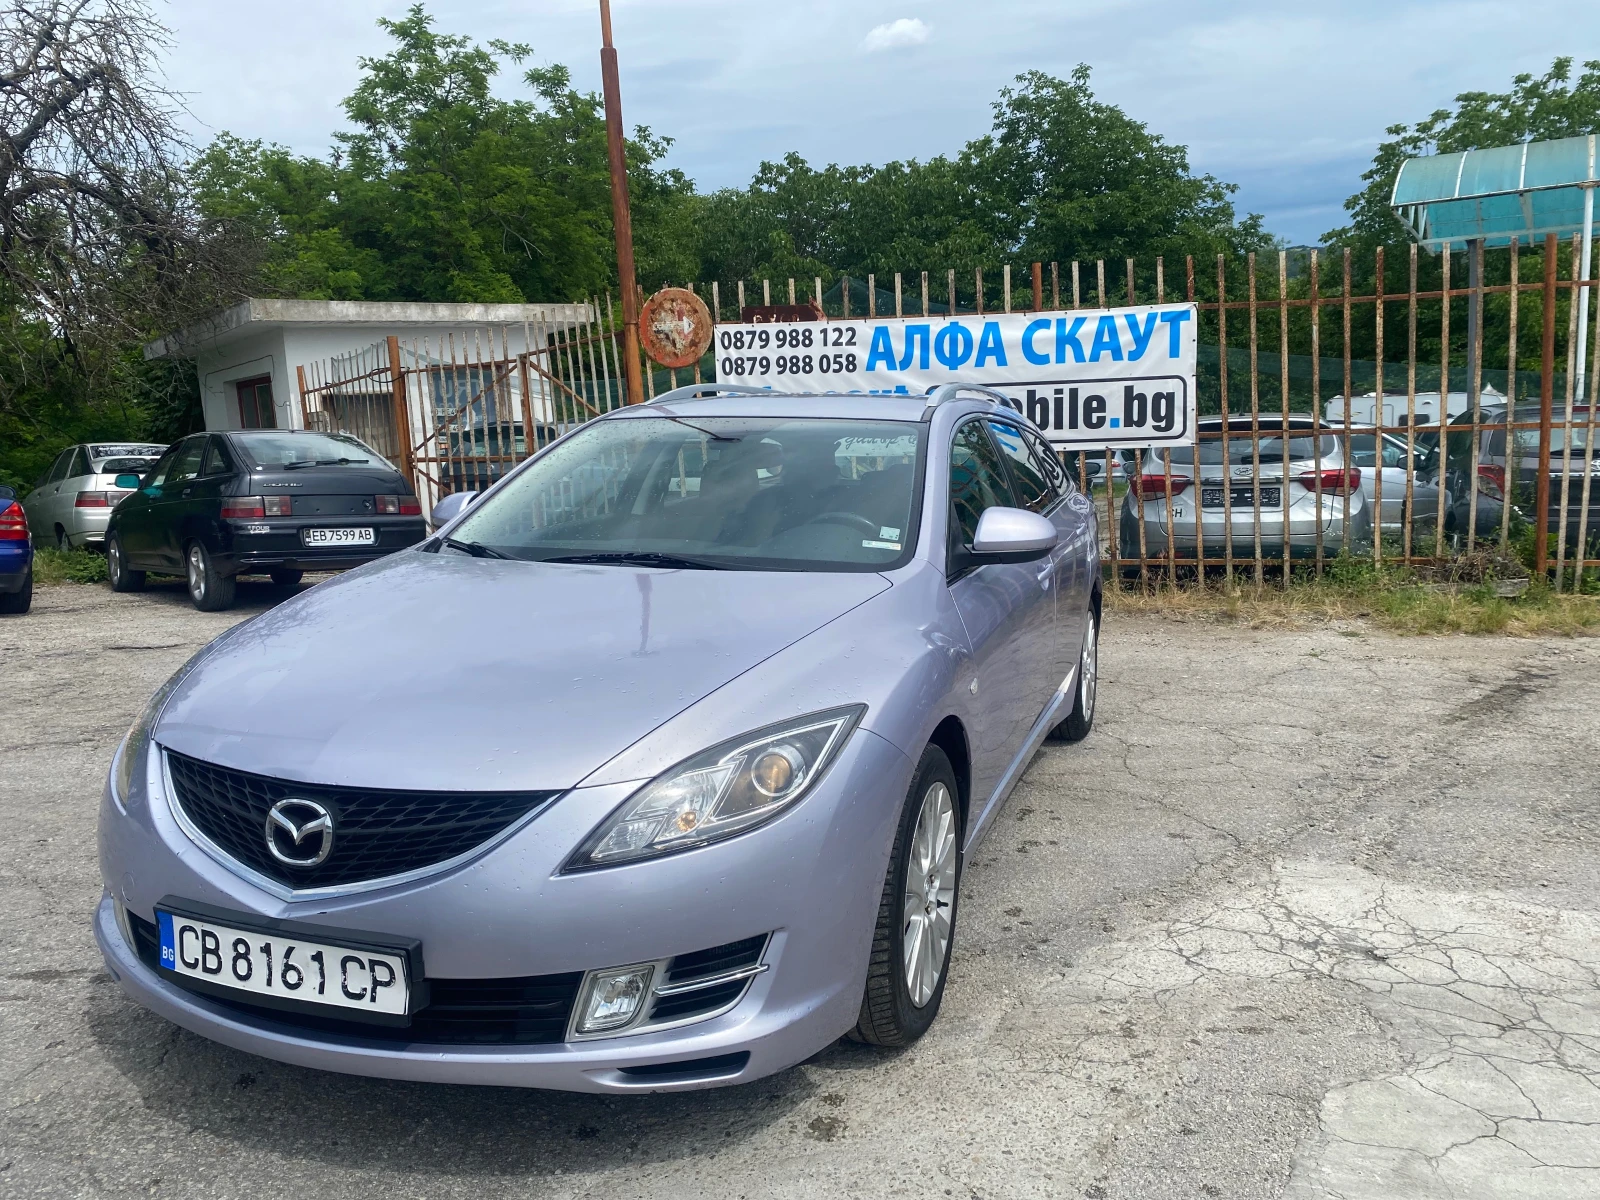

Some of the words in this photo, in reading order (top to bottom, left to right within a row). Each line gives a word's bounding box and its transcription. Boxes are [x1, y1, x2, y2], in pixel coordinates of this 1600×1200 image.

[720, 329, 770, 350] 0879
[775, 328, 814, 349] 988
[819, 326, 857, 347] 122
[866, 321, 1008, 372] АЛФА
[1022, 311, 1191, 366] СКАУТ
[721, 355, 771, 376] 0879
[775, 354, 814, 375] 988
[818, 353, 857, 374] 058
[312, 531, 327, 543] EB
[329, 530, 356, 541] 7599
[358, 529, 372, 541] AB
[162, 946, 174, 961] BG
[178, 925, 223, 975] CB
[231, 938, 326, 995] 8161
[340, 955, 396, 1003] CP
